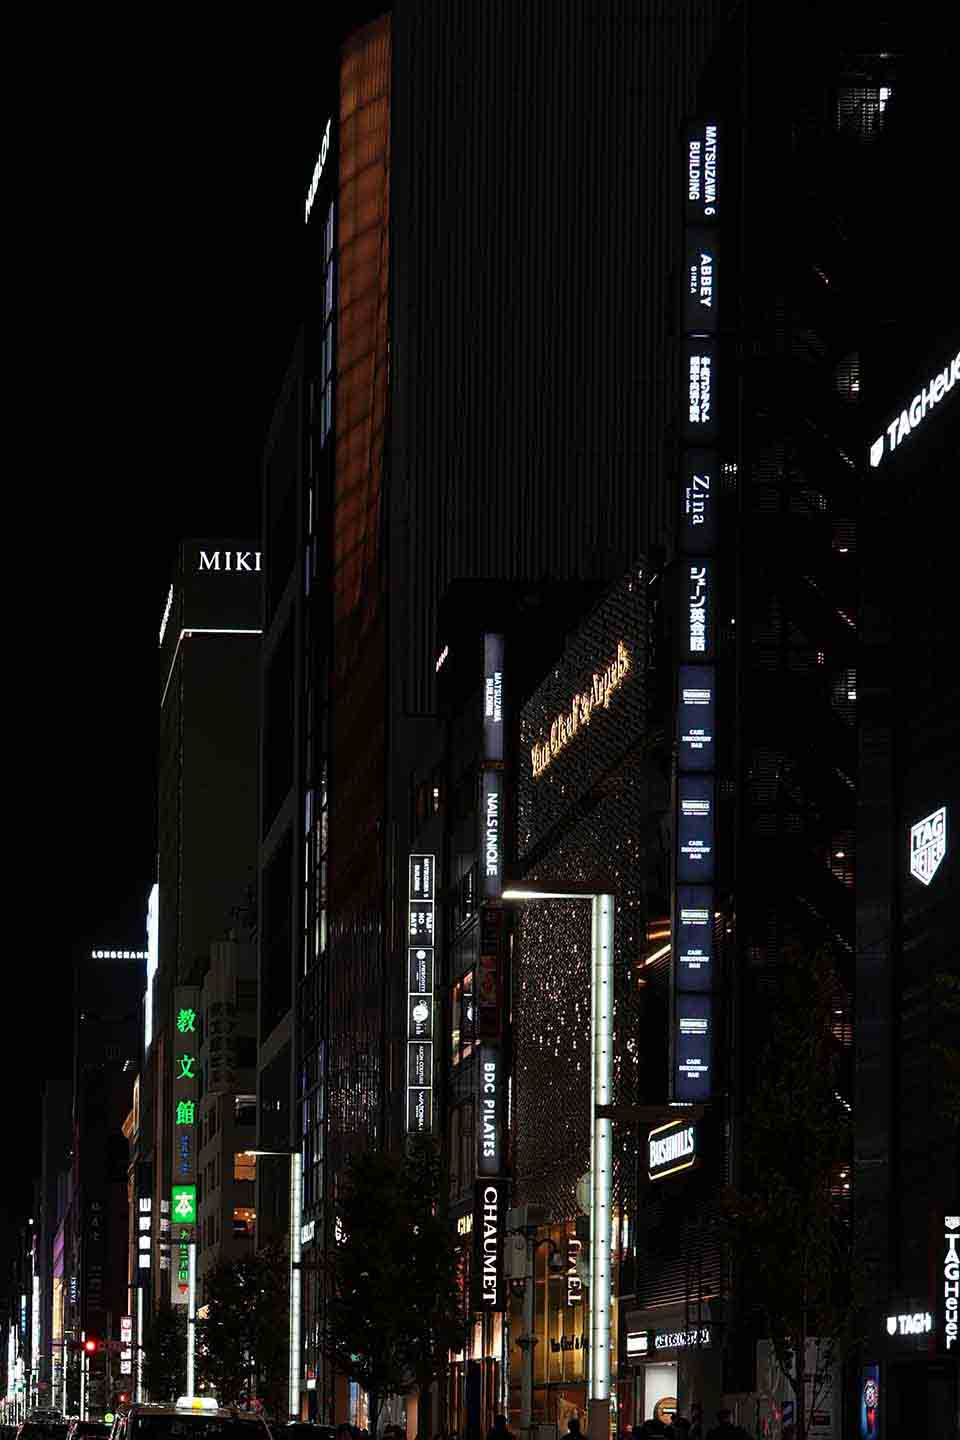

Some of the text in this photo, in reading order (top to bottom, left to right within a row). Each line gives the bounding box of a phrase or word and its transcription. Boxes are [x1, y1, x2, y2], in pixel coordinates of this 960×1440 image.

[688, 141, 701, 200] BUILDING
[704, 126, 717, 216] MATSUZAWA 6
[700, 253, 713, 308] ABBEY
[692, 475, 710, 525] Zina
[198, 551, 262, 571] MIKI
[689, 567, 706, 652] シェーン英会話
[485, 678, 494, 717] BUILDING
[494, 671, 503, 723] MATSUZAWA
[486, 792, 498, 876] NAILS UNIQUE
[913, 814, 944, 849] TAG
[176, 1008, 197, 1126] 教文館
[483, 1062, 496, 1158] BDC PILATES
[649, 1127, 695, 1169] BUSHMILLS
[175, 1191, 194, 1218] 本
[483, 1186, 498, 1305] CHAUMET
